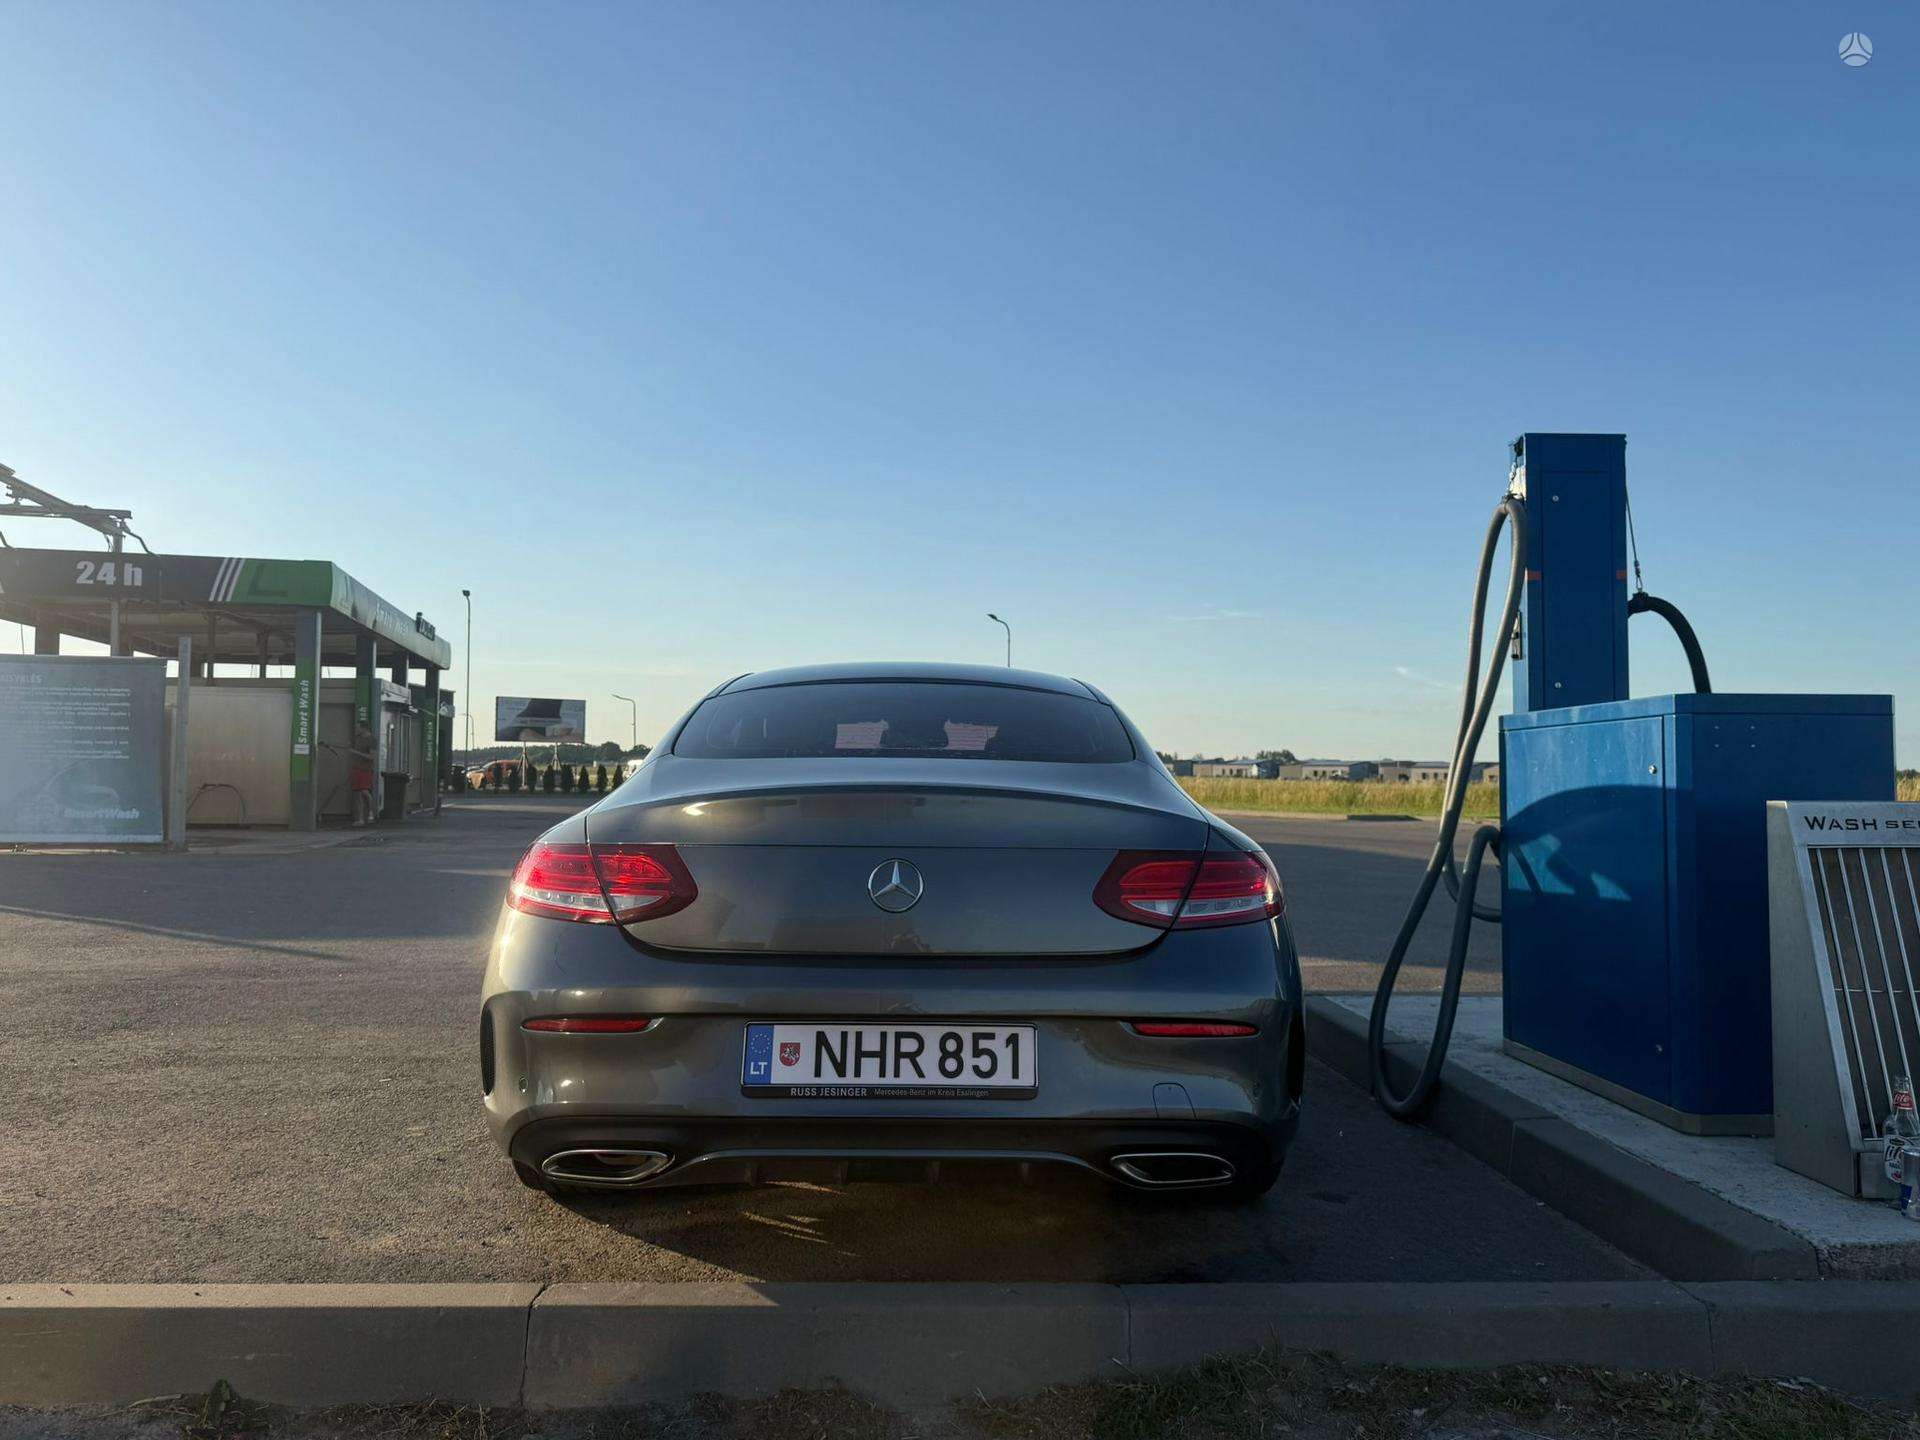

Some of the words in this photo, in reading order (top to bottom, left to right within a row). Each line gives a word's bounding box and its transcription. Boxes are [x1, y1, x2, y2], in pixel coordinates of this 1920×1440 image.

[76, 560, 116, 586] 24
[124, 562, 143, 587] h
[299, 680, 309, 709] Wash
[298, 711, 308, 744] Smart
[1804, 816, 1878, 831] WASH
[1885, 820, 1920, 829] SE
[750, 1061, 768, 1075] LT
[813, 1030, 927, 1079] NHR
[938, 1032, 1021, 1080] 851
[790, 1087, 817, 1097] RUSS
[820, 1088, 867, 1097] JESINGER
